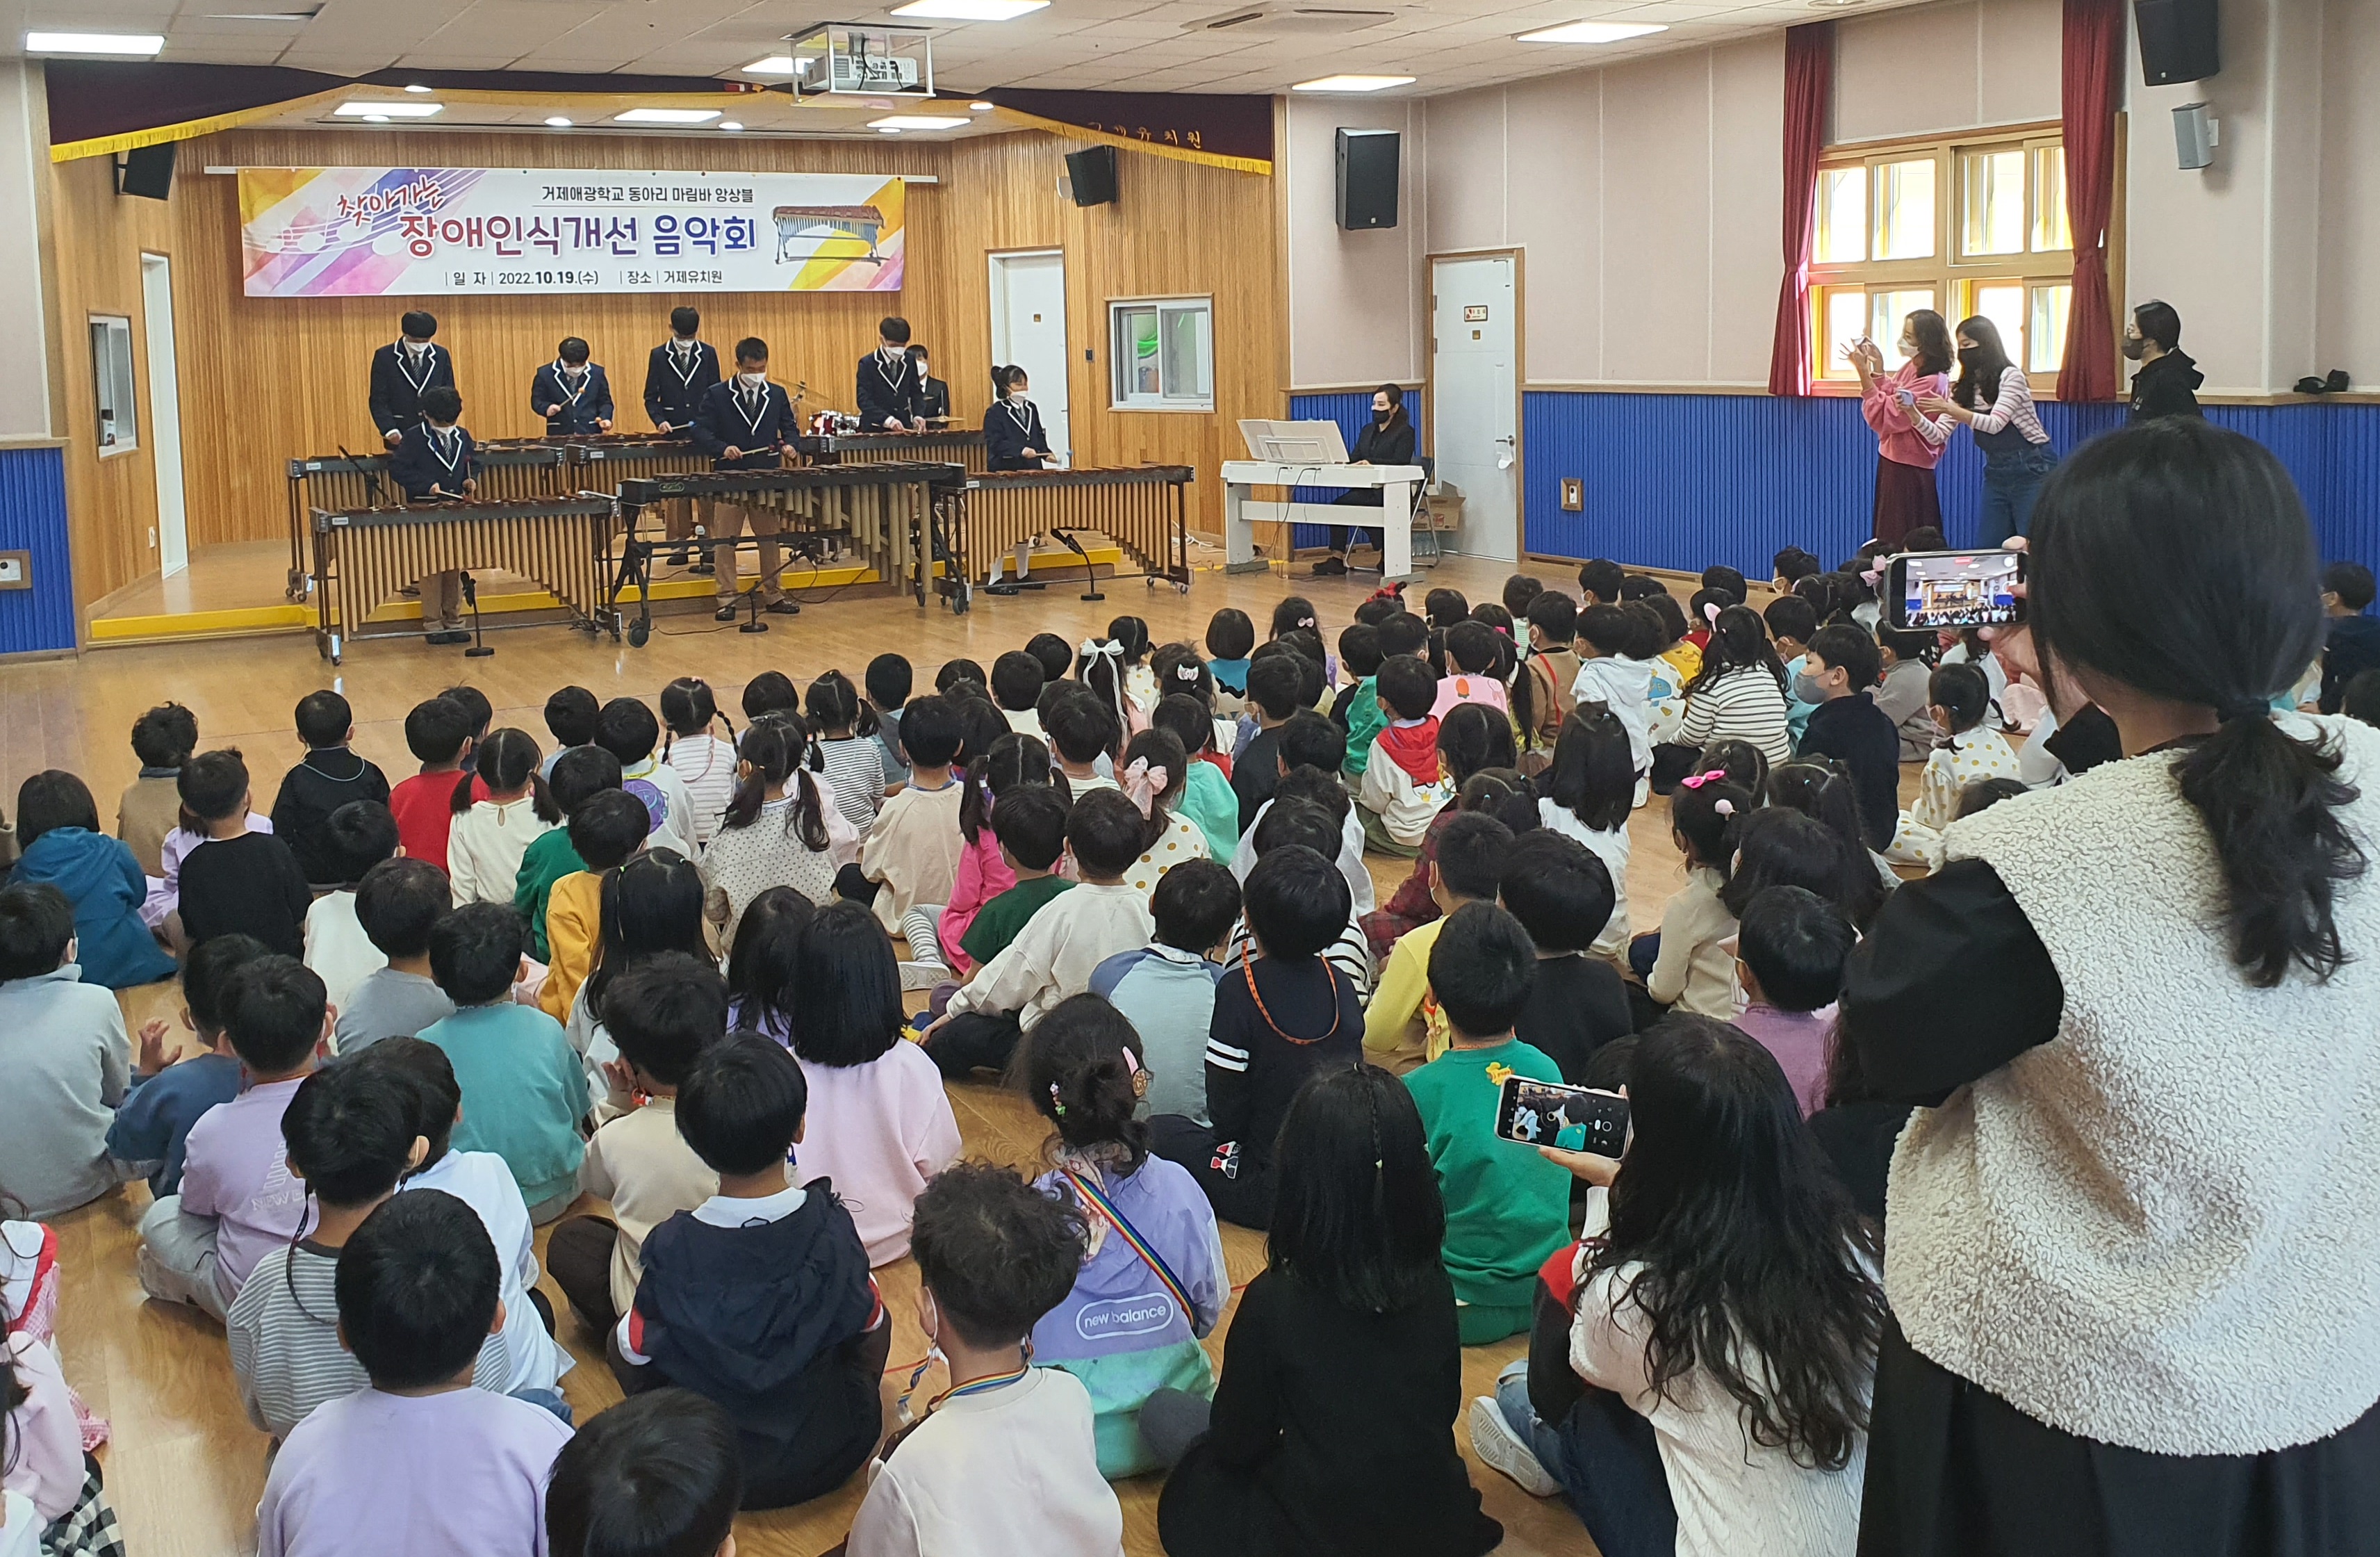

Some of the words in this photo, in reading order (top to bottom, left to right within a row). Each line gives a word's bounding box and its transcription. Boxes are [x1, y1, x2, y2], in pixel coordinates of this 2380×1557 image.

[337, 176, 444, 227] 찾아가는
[541, 186, 625, 202] 거제애광학교
[629, 187, 668, 202] 동아리
[673, 188, 712, 203] 마림바
[715, 188, 754, 203] 앙상블
[400, 215, 637, 257] 장애인식개선
[653, 215, 755, 255] 음악회
[627, 270, 653, 284] 장소
[664, 270, 723, 284] 거제유치원
[251, 1191, 290, 1212] NEW
[1084, 1312, 1110, 1329] new
[1110, 1305, 1167, 1323] balance
